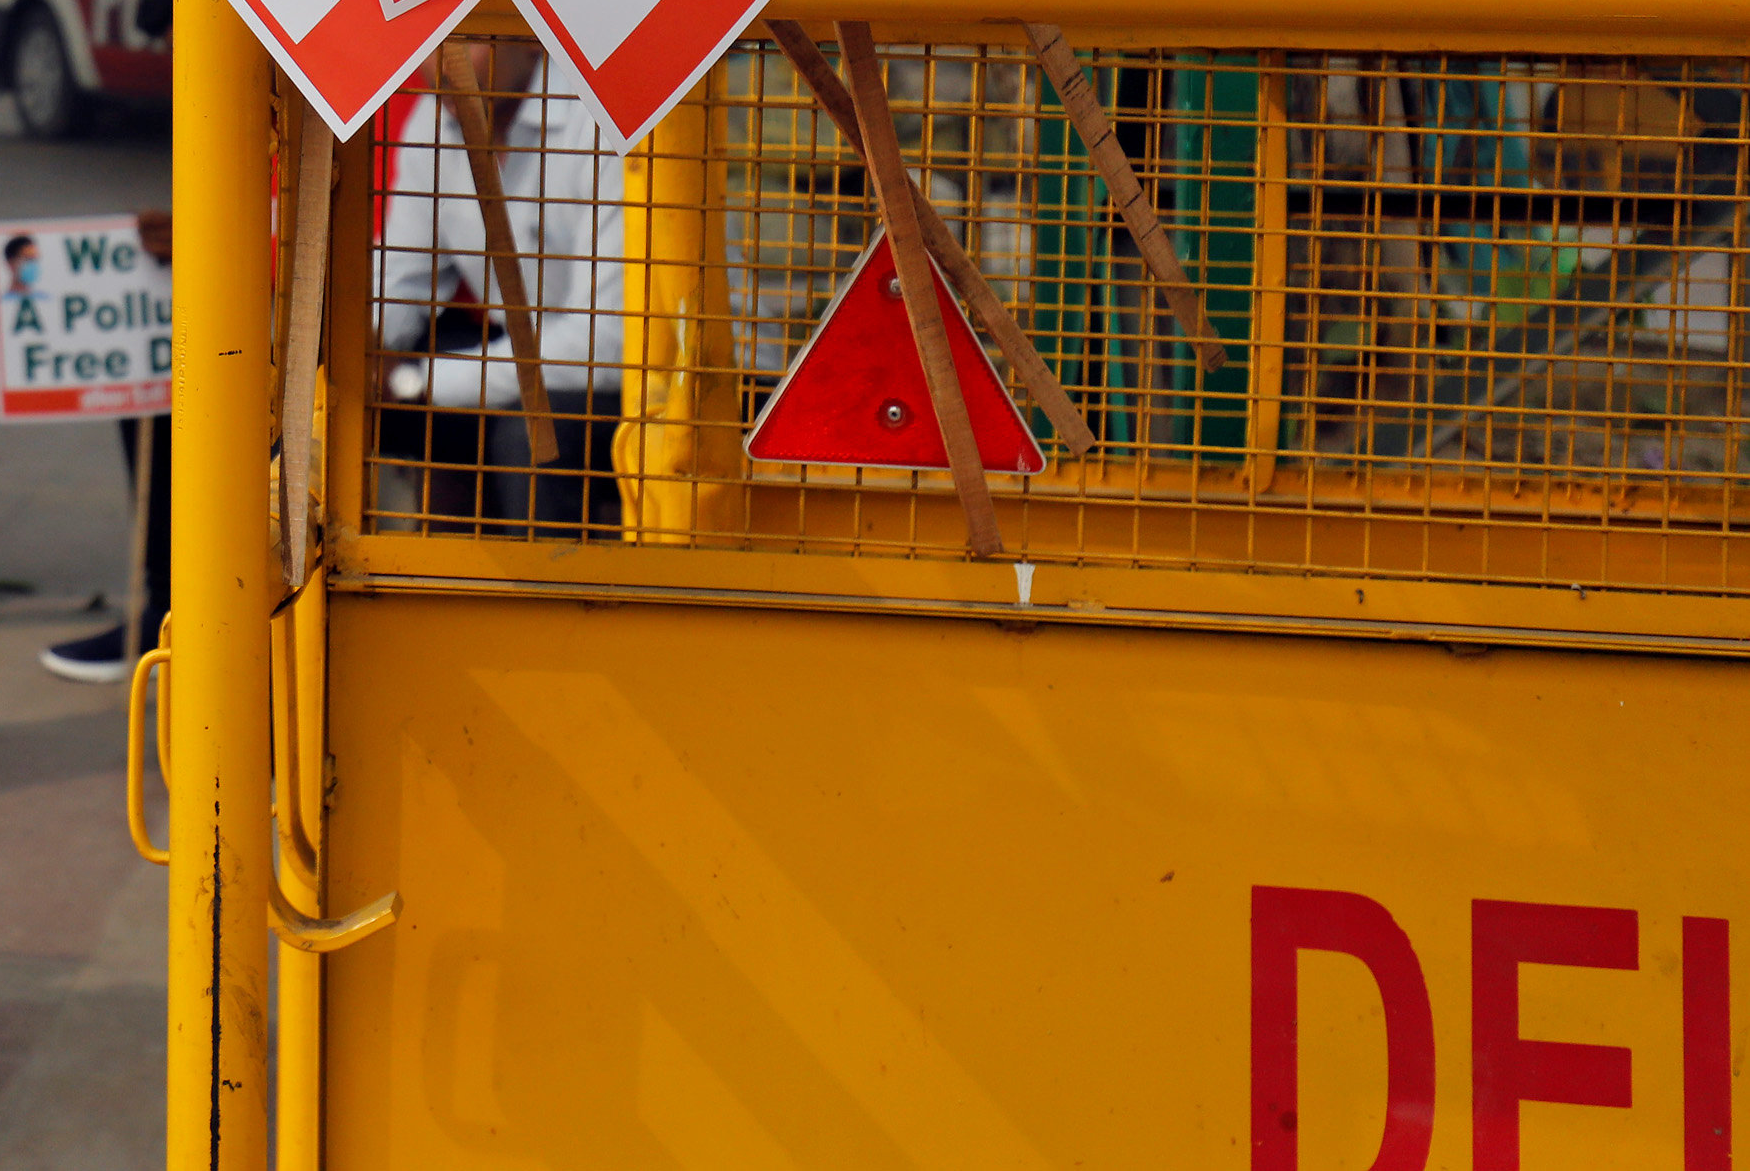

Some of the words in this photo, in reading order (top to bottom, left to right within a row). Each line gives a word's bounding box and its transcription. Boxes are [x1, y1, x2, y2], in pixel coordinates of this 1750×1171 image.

[65, 235, 136, 273] We
[13, 297, 42, 336] A
[64, 291, 172, 332] Pollu
[25, 344, 130, 381] Free
